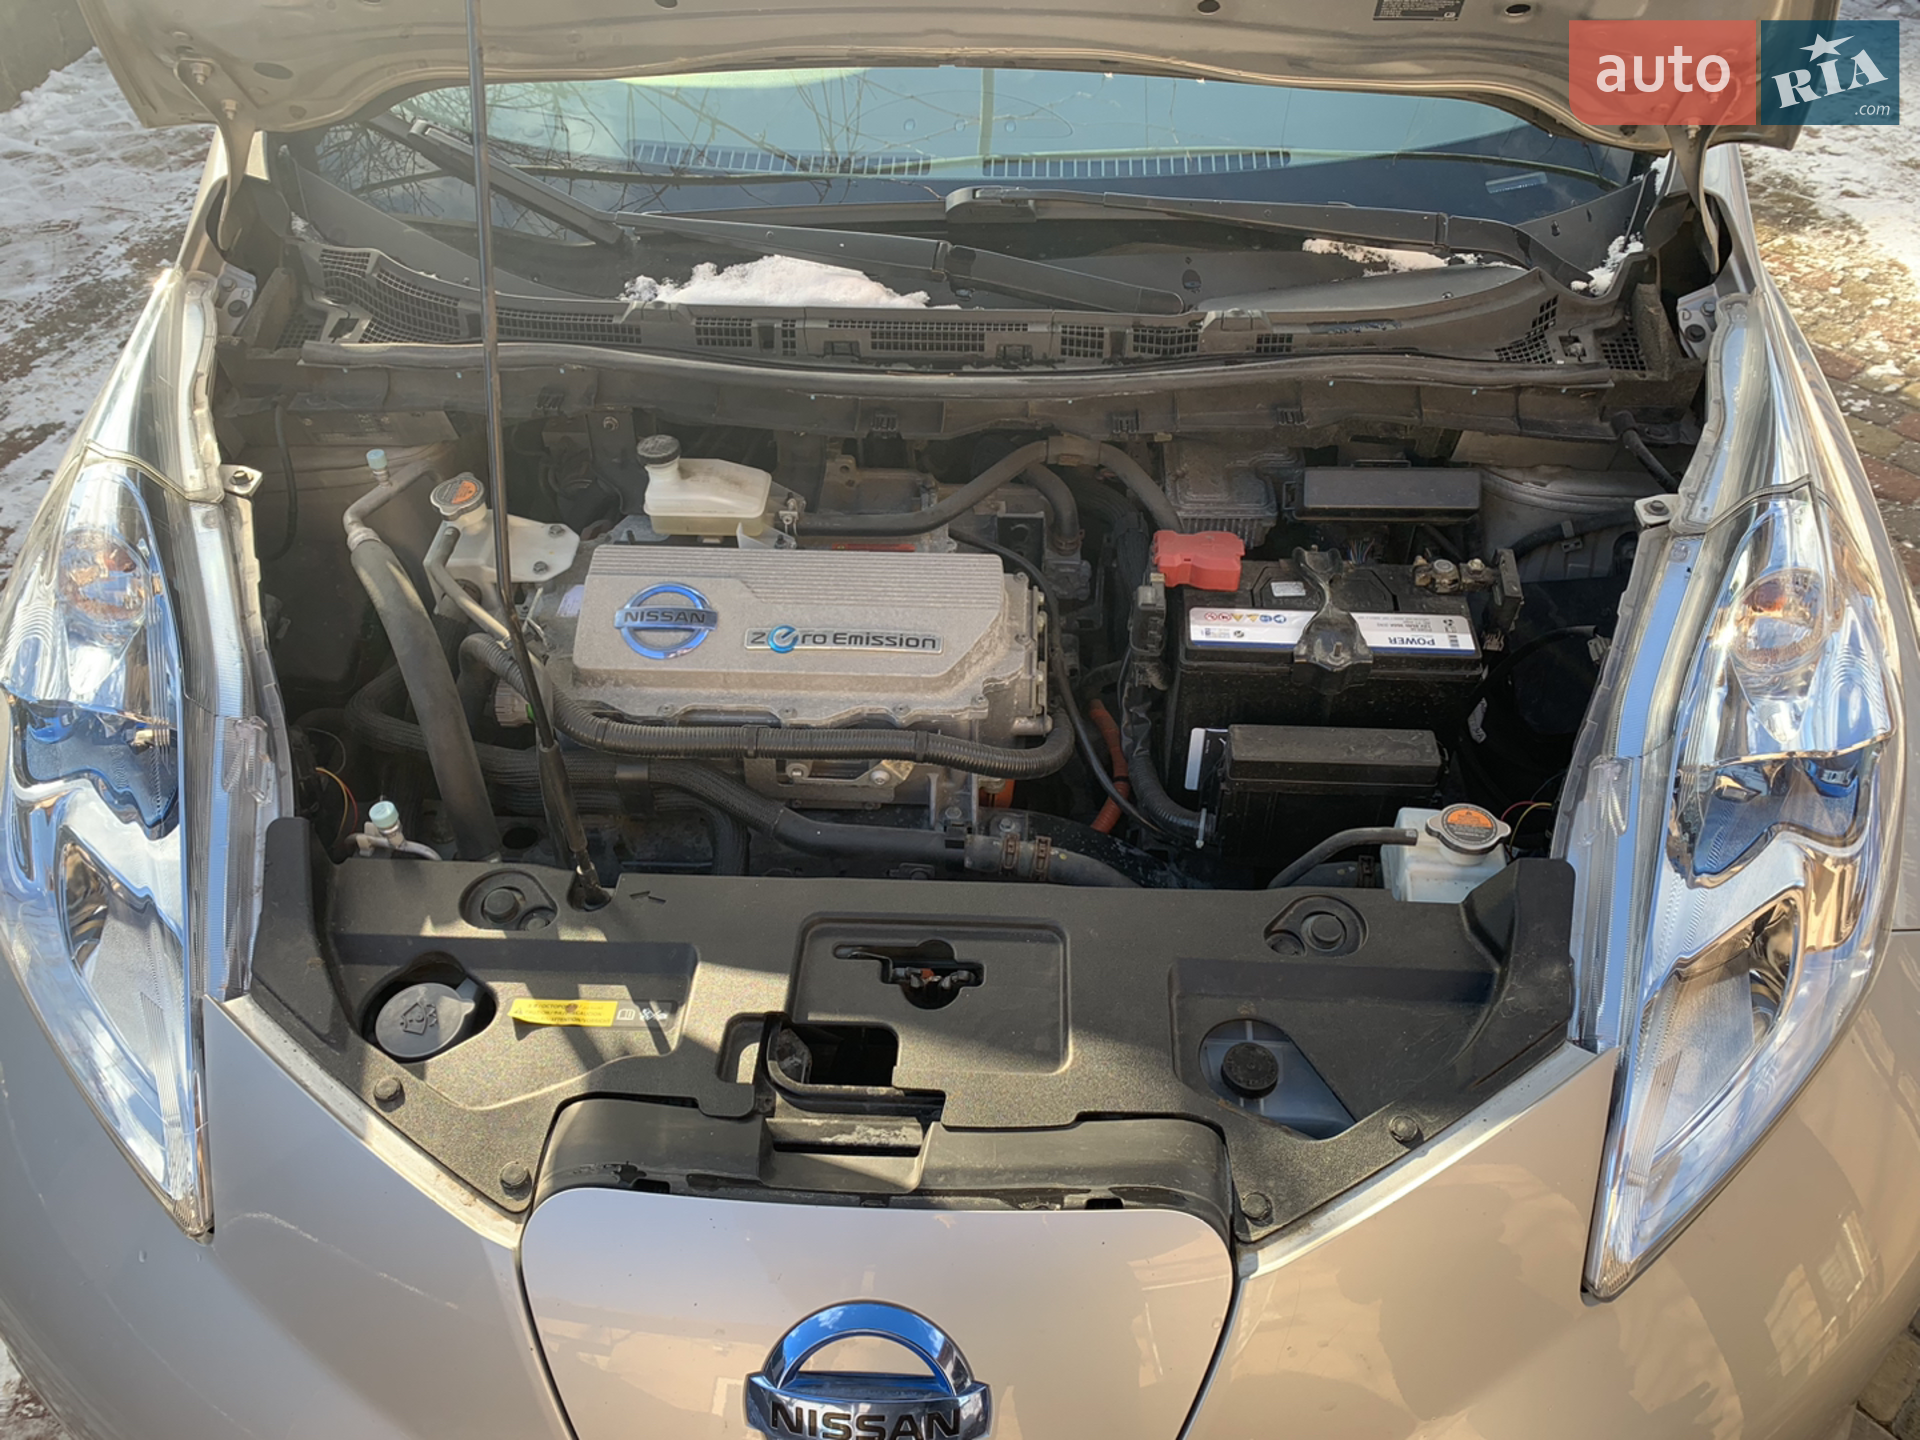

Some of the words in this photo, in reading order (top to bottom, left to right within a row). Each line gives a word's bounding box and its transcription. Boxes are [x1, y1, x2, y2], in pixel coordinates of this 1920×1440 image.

[624, 610, 706, 624] NISSAN
[833, 632, 937, 649] Emission
[1388, 637, 1435, 646] POWER
[771, 1401, 961, 1440] NISSAN
